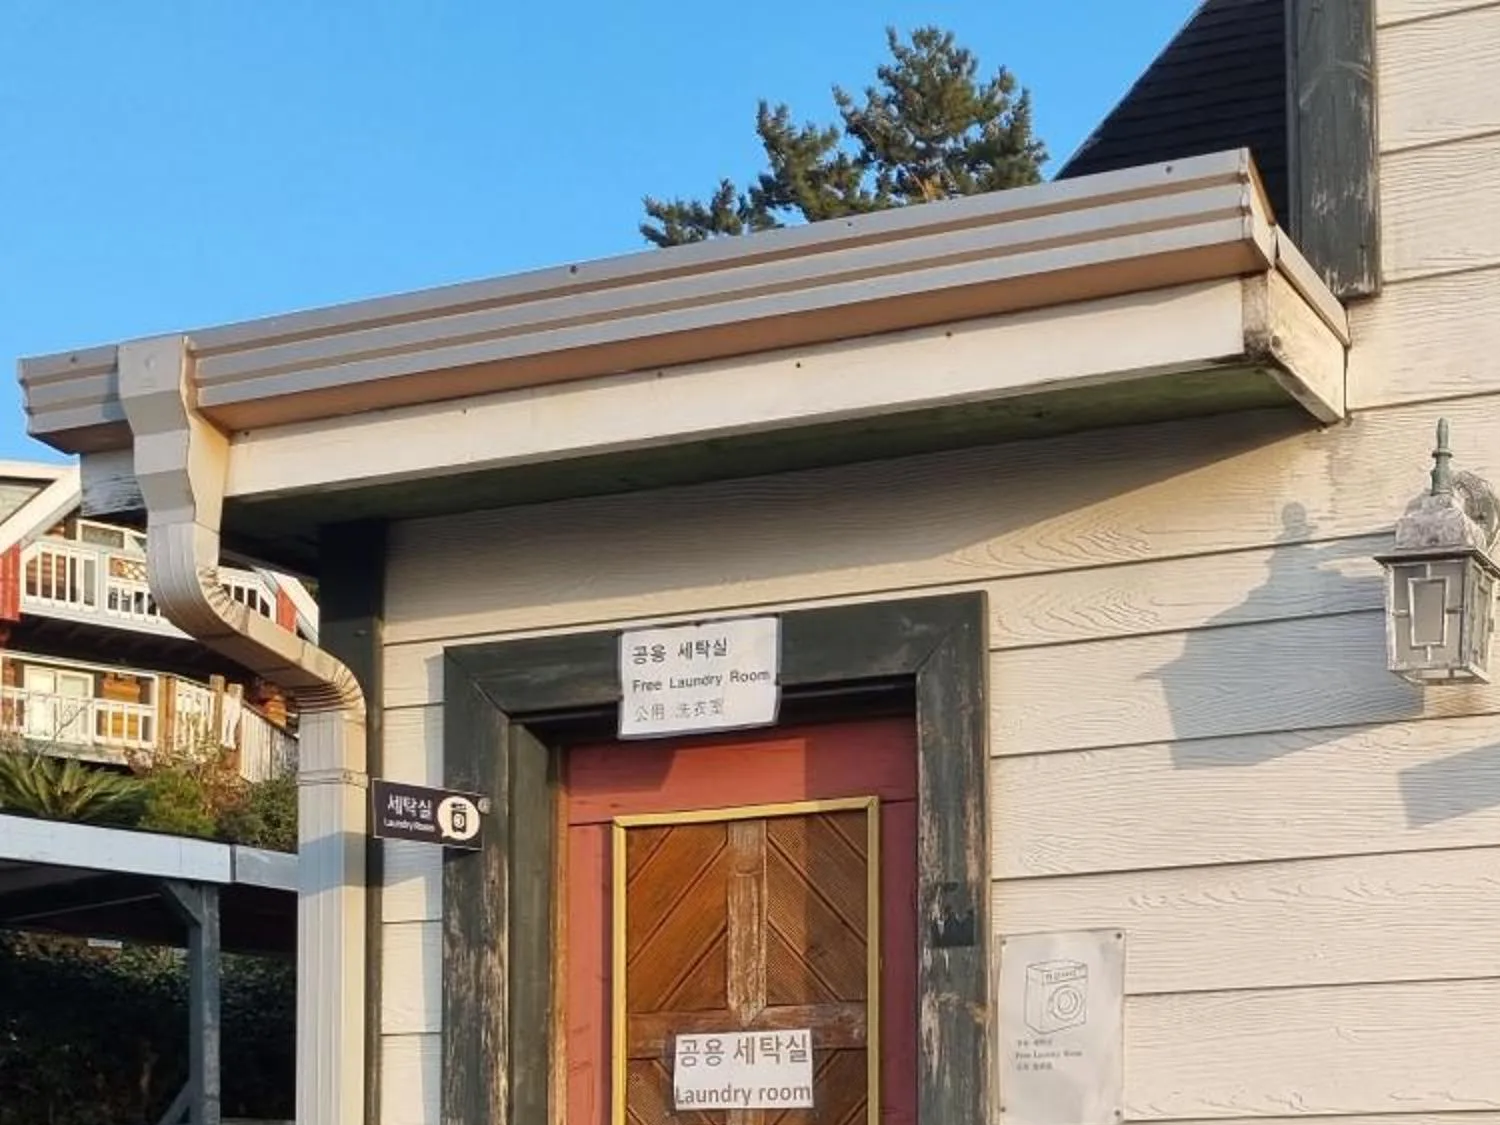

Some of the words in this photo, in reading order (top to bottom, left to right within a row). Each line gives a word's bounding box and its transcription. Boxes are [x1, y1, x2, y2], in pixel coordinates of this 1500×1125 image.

[632, 643, 667, 665] 공용
[677, 637, 728, 661] 세탁실
[632, 678, 663, 694] Free
[669, 672, 723, 690] Laundry
[729, 669, 771, 684] Room
[387, 792, 432, 819] 세탁실
[678, 1038, 725, 1068] 공용
[733, 1034, 809, 1066] 세탁실
[675, 1081, 753, 1107] Laundry
[758, 1084, 812, 1102] room
